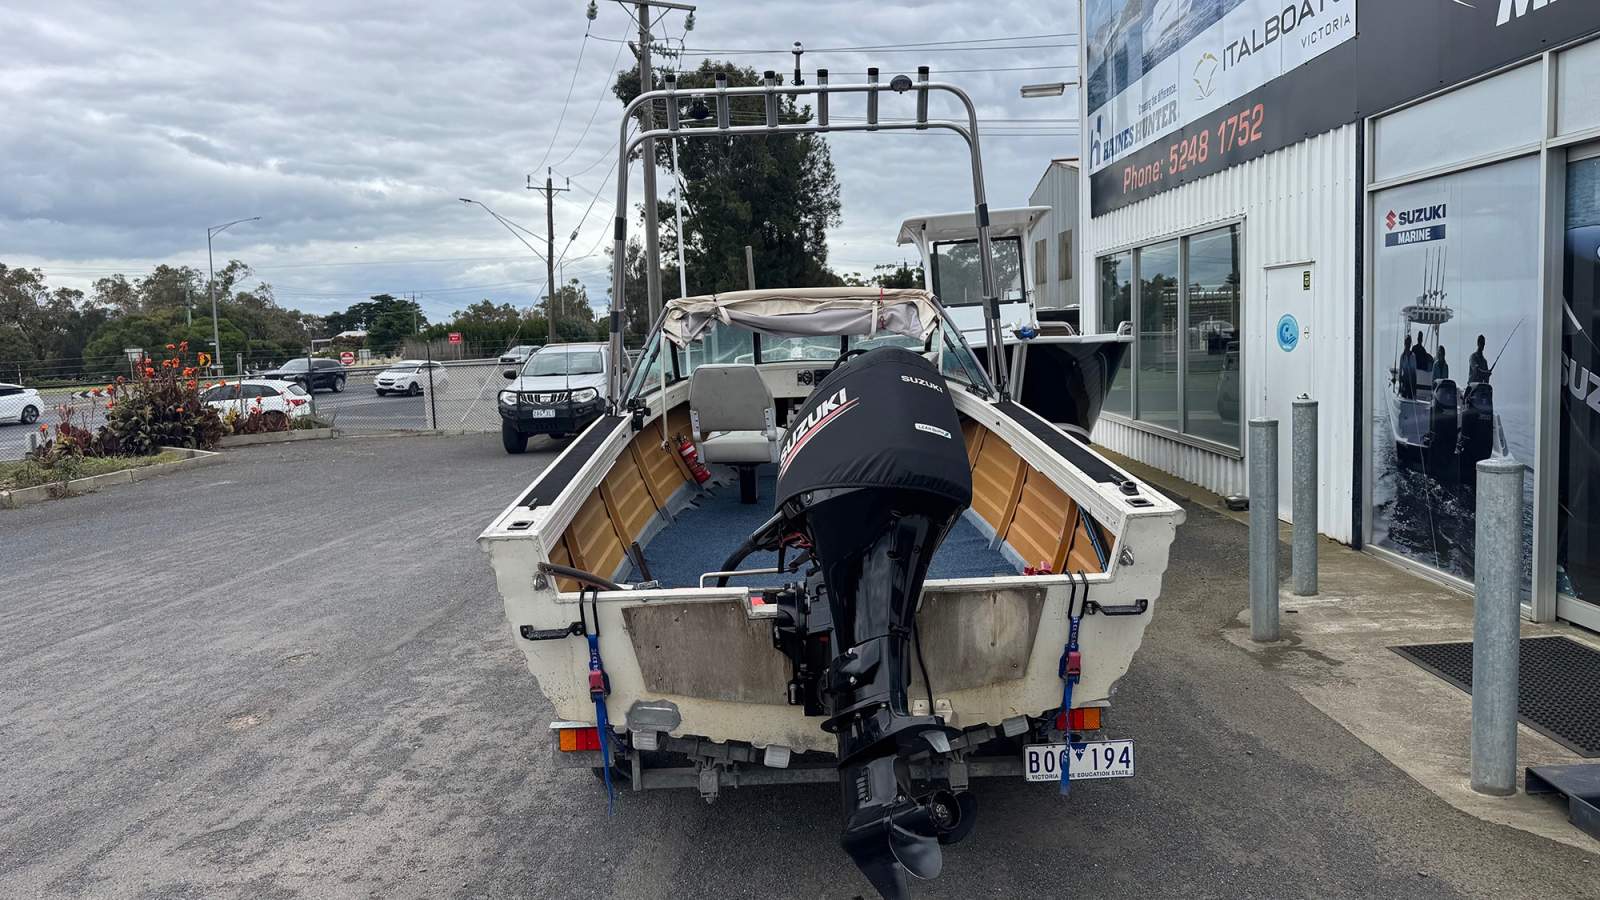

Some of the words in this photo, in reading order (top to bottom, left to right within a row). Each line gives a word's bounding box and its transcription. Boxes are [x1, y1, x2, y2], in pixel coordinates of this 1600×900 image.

[1223, 0, 1341, 71] ITALBOA
[1301, 13, 1351, 48] VICTORIA
[1103, 126, 1135, 161] HAINES
[1135, 99, 1177, 144] HUNTER
[1123, 158, 1164, 194] Phone:
[1169, 129, 1209, 175] 5248
[1217, 103, 1264, 155] 1752
[1398, 203, 1447, 225] SUZUKI
[1398, 228, 1431, 244] MARINE
[901, 375, 943, 393] SUZUKI
[780, 387, 847, 467] SUZUKI
[1091, 746, 1131, 771] 194
